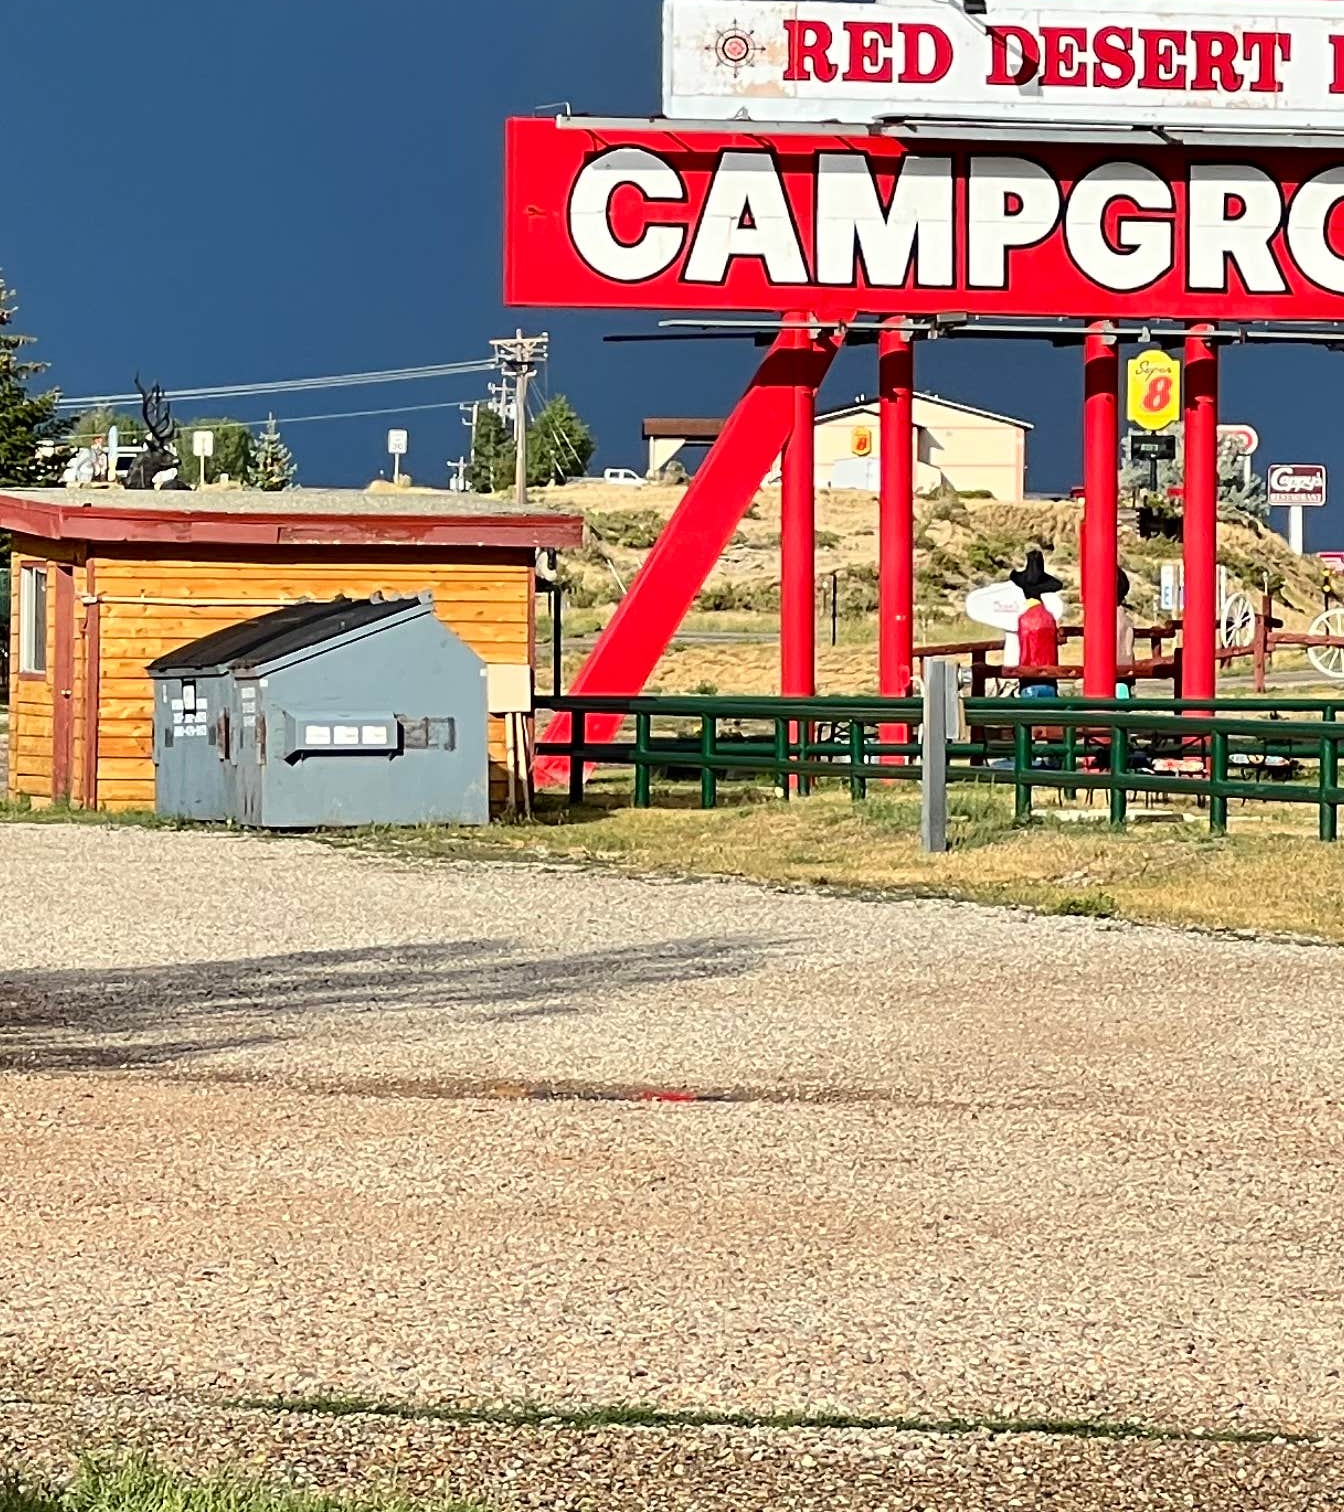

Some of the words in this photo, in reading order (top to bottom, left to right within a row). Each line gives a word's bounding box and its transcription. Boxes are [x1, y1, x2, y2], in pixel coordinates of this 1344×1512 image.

[782, 19, 954, 85] RED
[986, 25, 1292, 93] DESERT
[1143, 376, 1173, 412] 8
